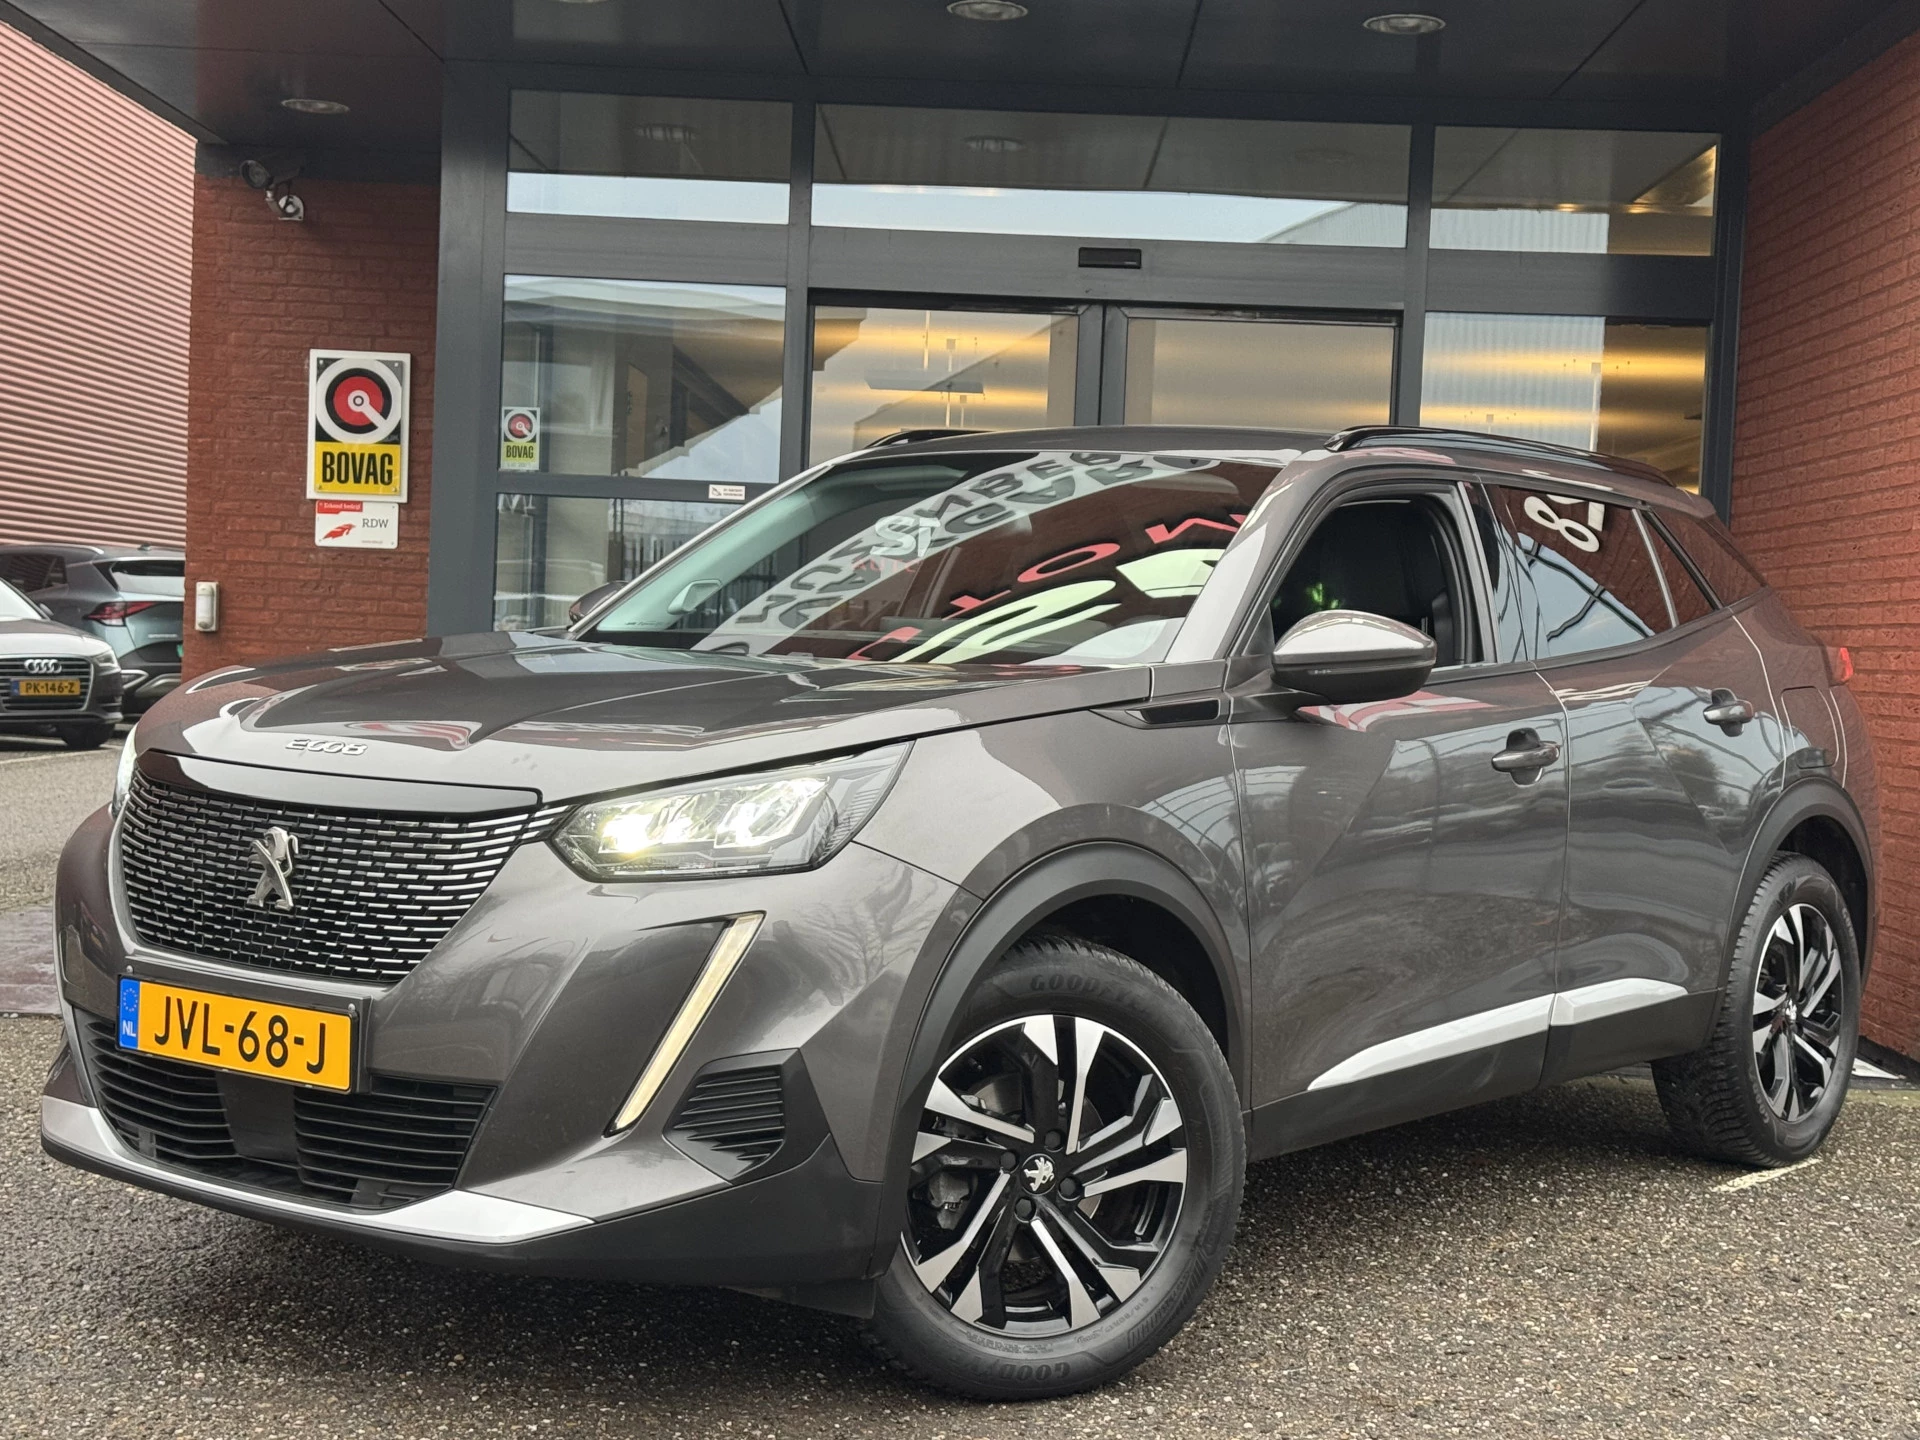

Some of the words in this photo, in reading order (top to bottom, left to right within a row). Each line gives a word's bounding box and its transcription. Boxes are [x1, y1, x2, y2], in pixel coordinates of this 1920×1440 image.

[506, 445, 534, 459] BOVAG
[322, 451, 393, 486] BOVAG
[362, 518, 389, 529] RDW
[25, 682, 75, 694] PK-146-Z
[121, 1019, 137, 1038] NL
[154, 995, 327, 1075] JVL-68-J
